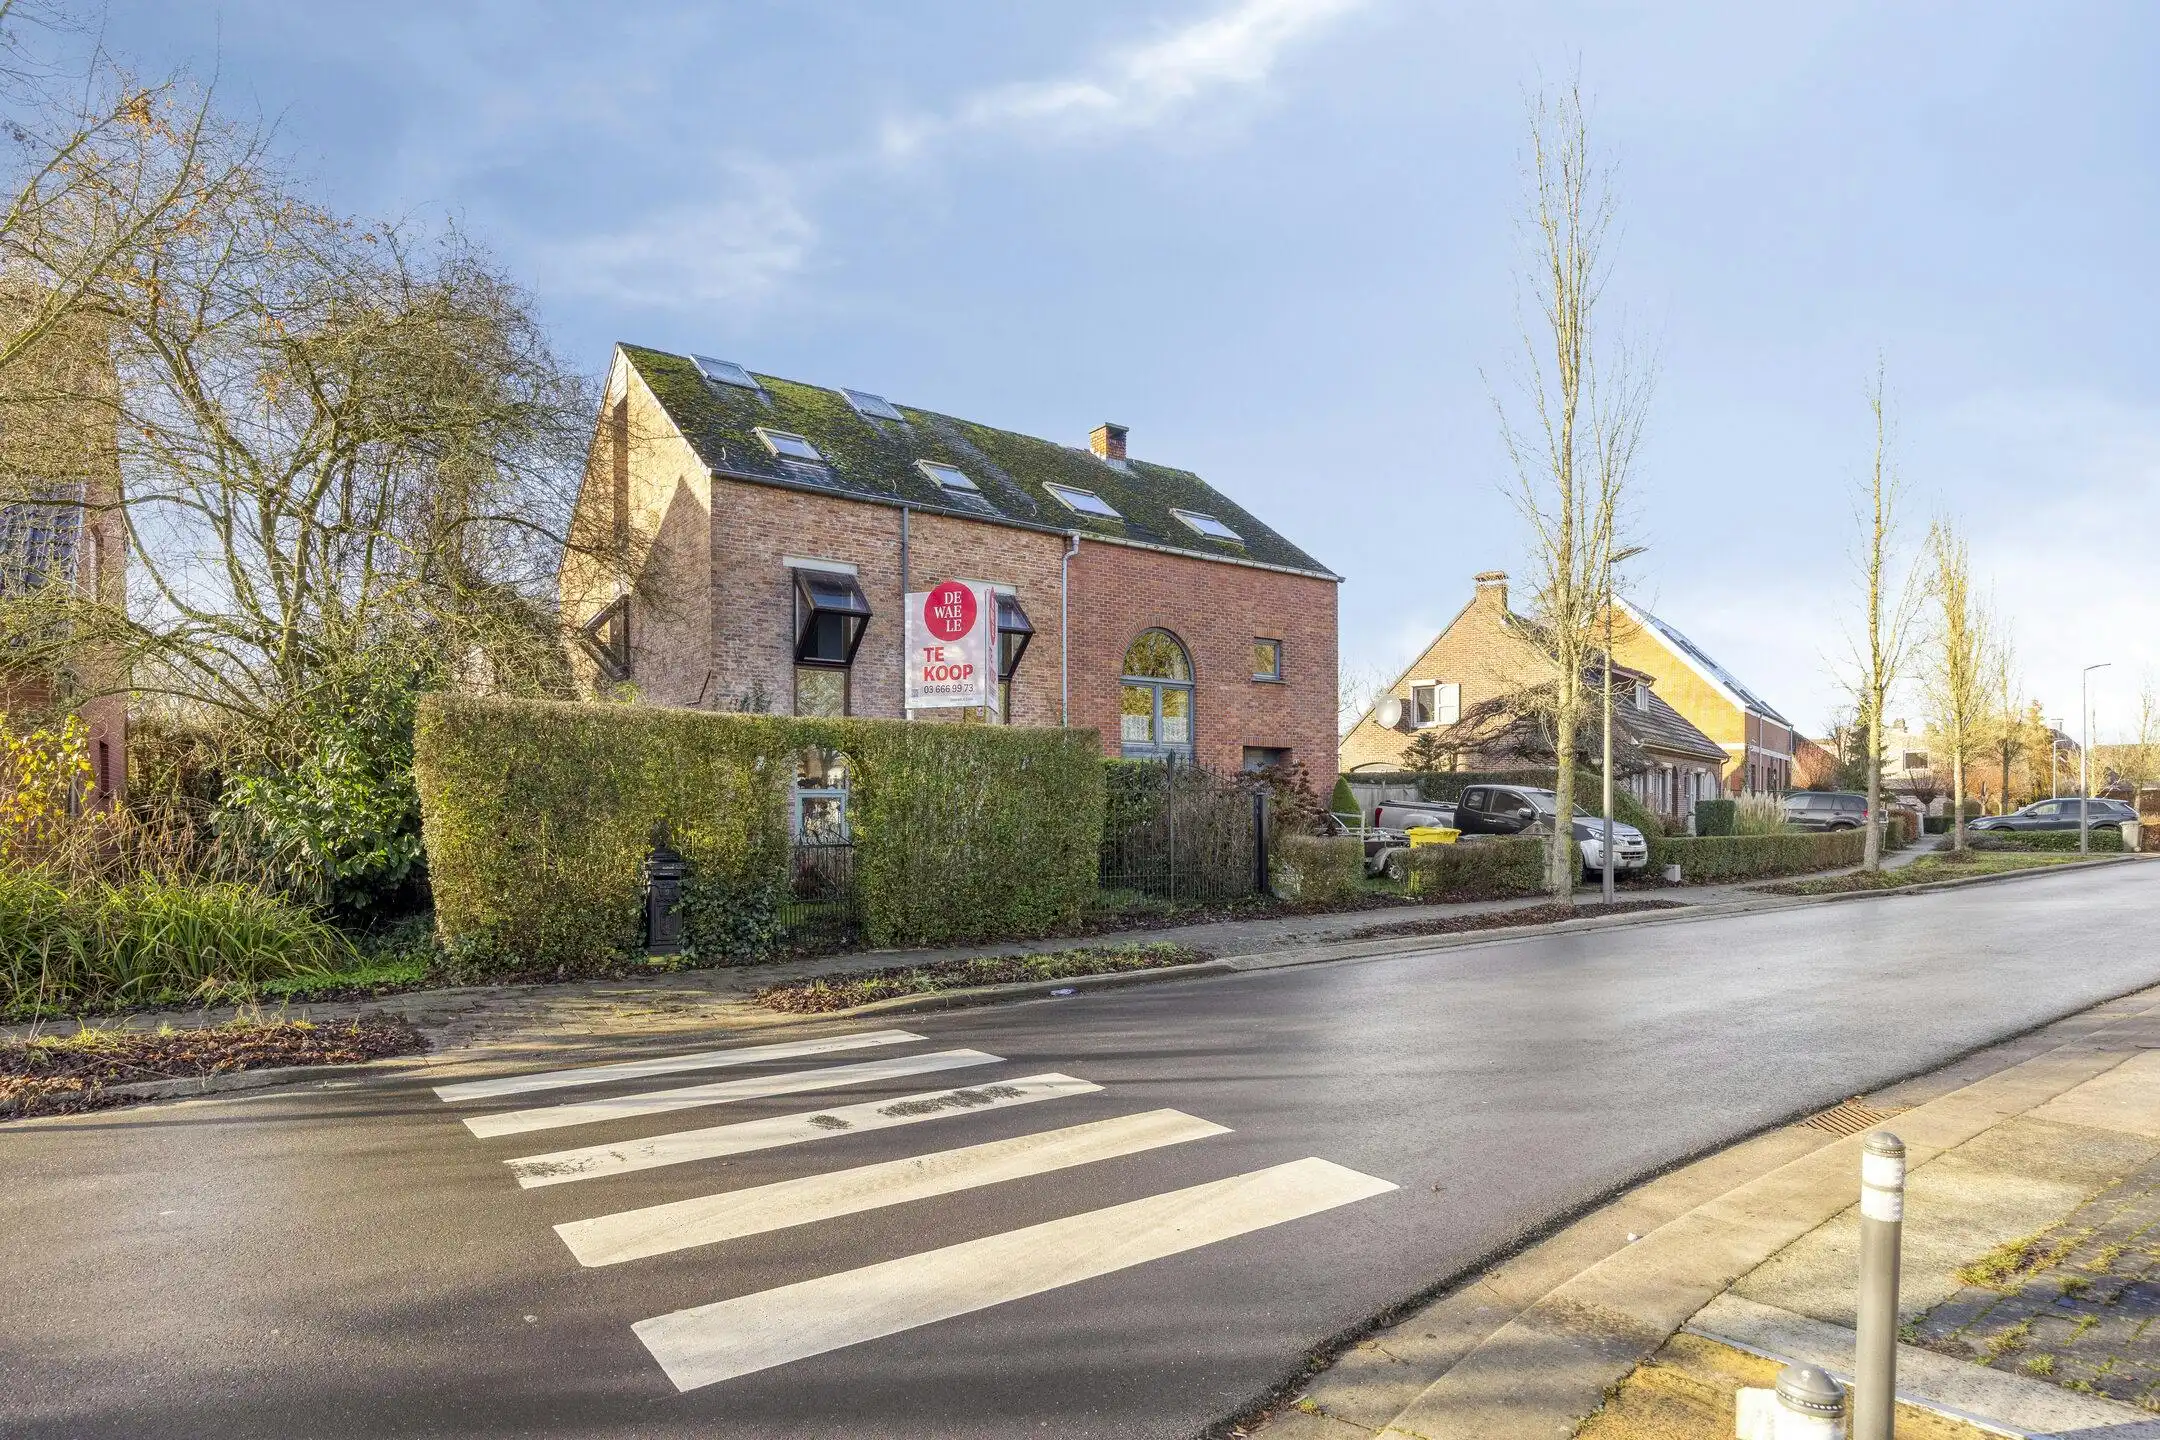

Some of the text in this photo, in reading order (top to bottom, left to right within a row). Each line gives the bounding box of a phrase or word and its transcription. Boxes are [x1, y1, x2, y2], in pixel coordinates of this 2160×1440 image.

[944, 591, 962, 605] DE
[934, 605, 962, 619] WAE
[946, 619, 962, 632] LE
[923, 647, 944, 662] TE
[924, 664, 974, 681] KOOP
[924, 683, 974, 694] 03 666 99 73
